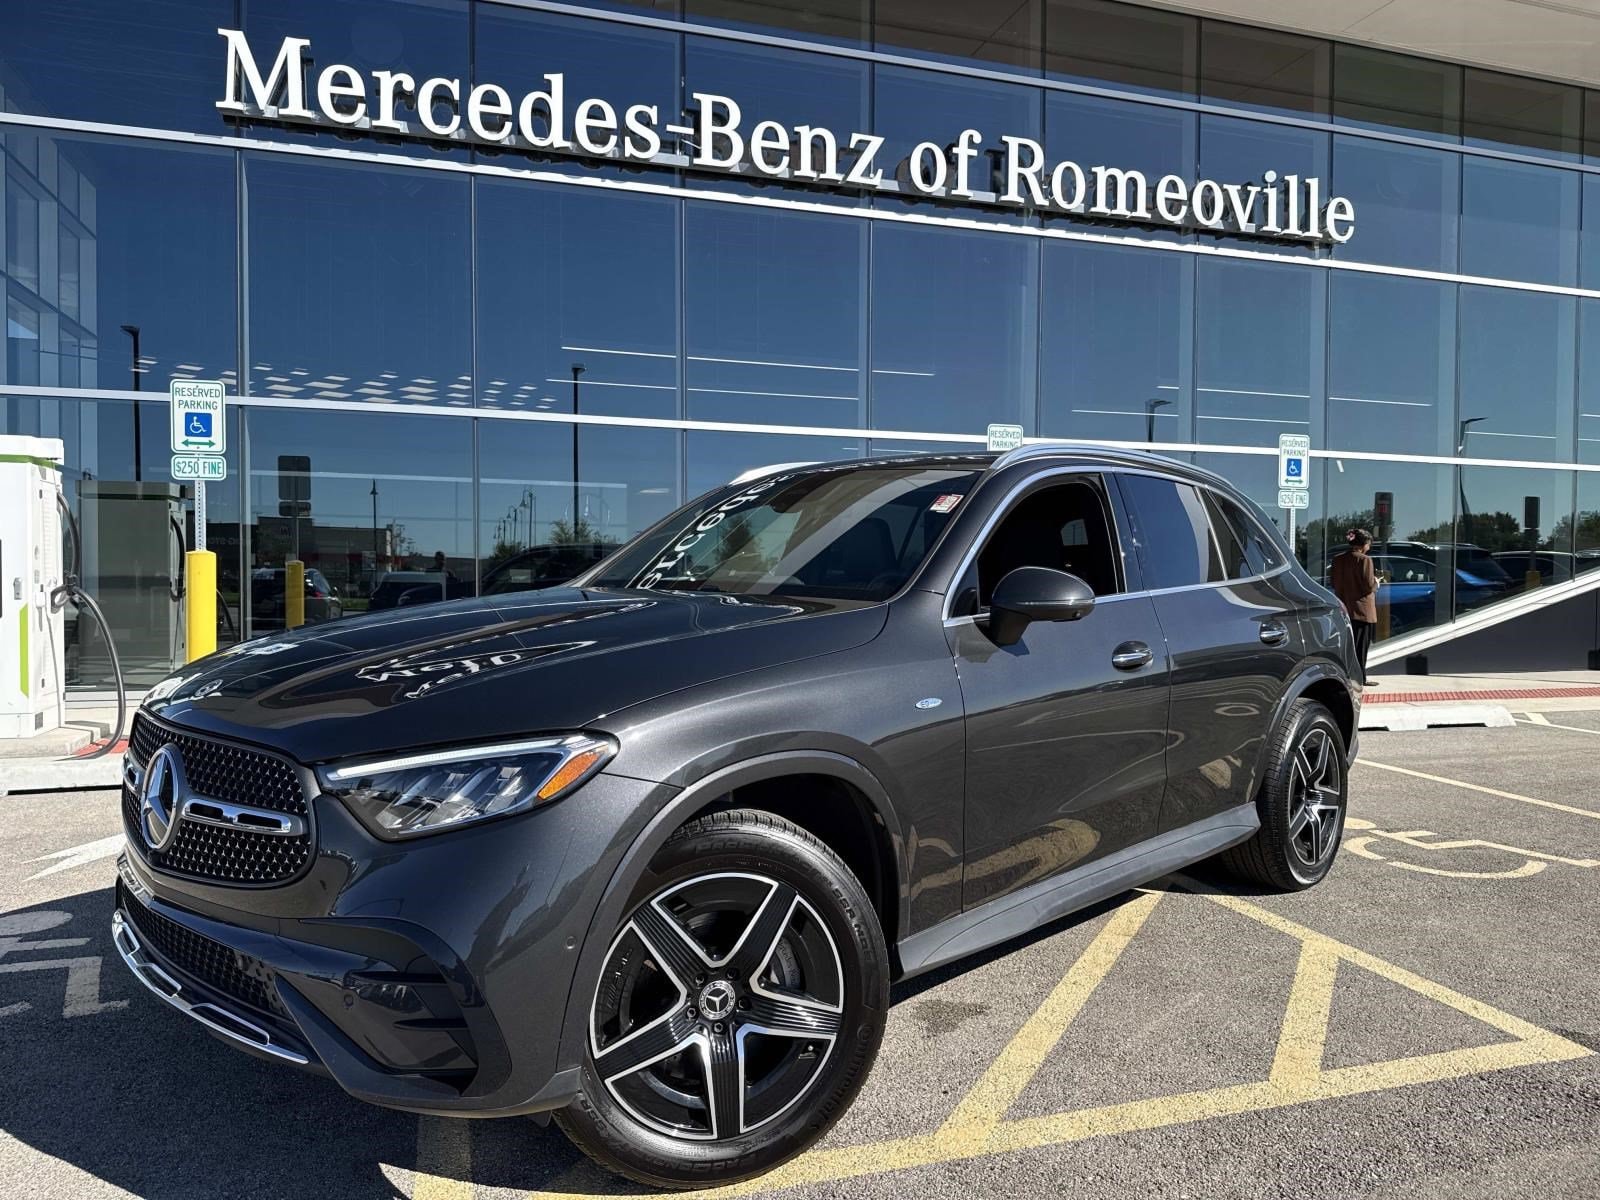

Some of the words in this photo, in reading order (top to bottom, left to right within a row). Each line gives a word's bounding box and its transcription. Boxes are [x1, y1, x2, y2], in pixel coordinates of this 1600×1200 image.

[215, 28, 885, 187] Mercedes-Benz
[910, 128, 983, 197] of
[999, 135, 1356, 243] Romeoville
[175, 387, 221, 398] RESERVED
[178, 399, 218, 410] PARKING
[990, 430, 1021, 439] RESERVED
[1281, 439, 1308, 448] RESERVED
[1283, 449, 1306, 457] PARKING
[175, 460, 199, 474] $250
[203, 461, 223, 475] FINE
[1280, 494, 1294, 504] $250
[1295, 495, 1307, 504] FINE
